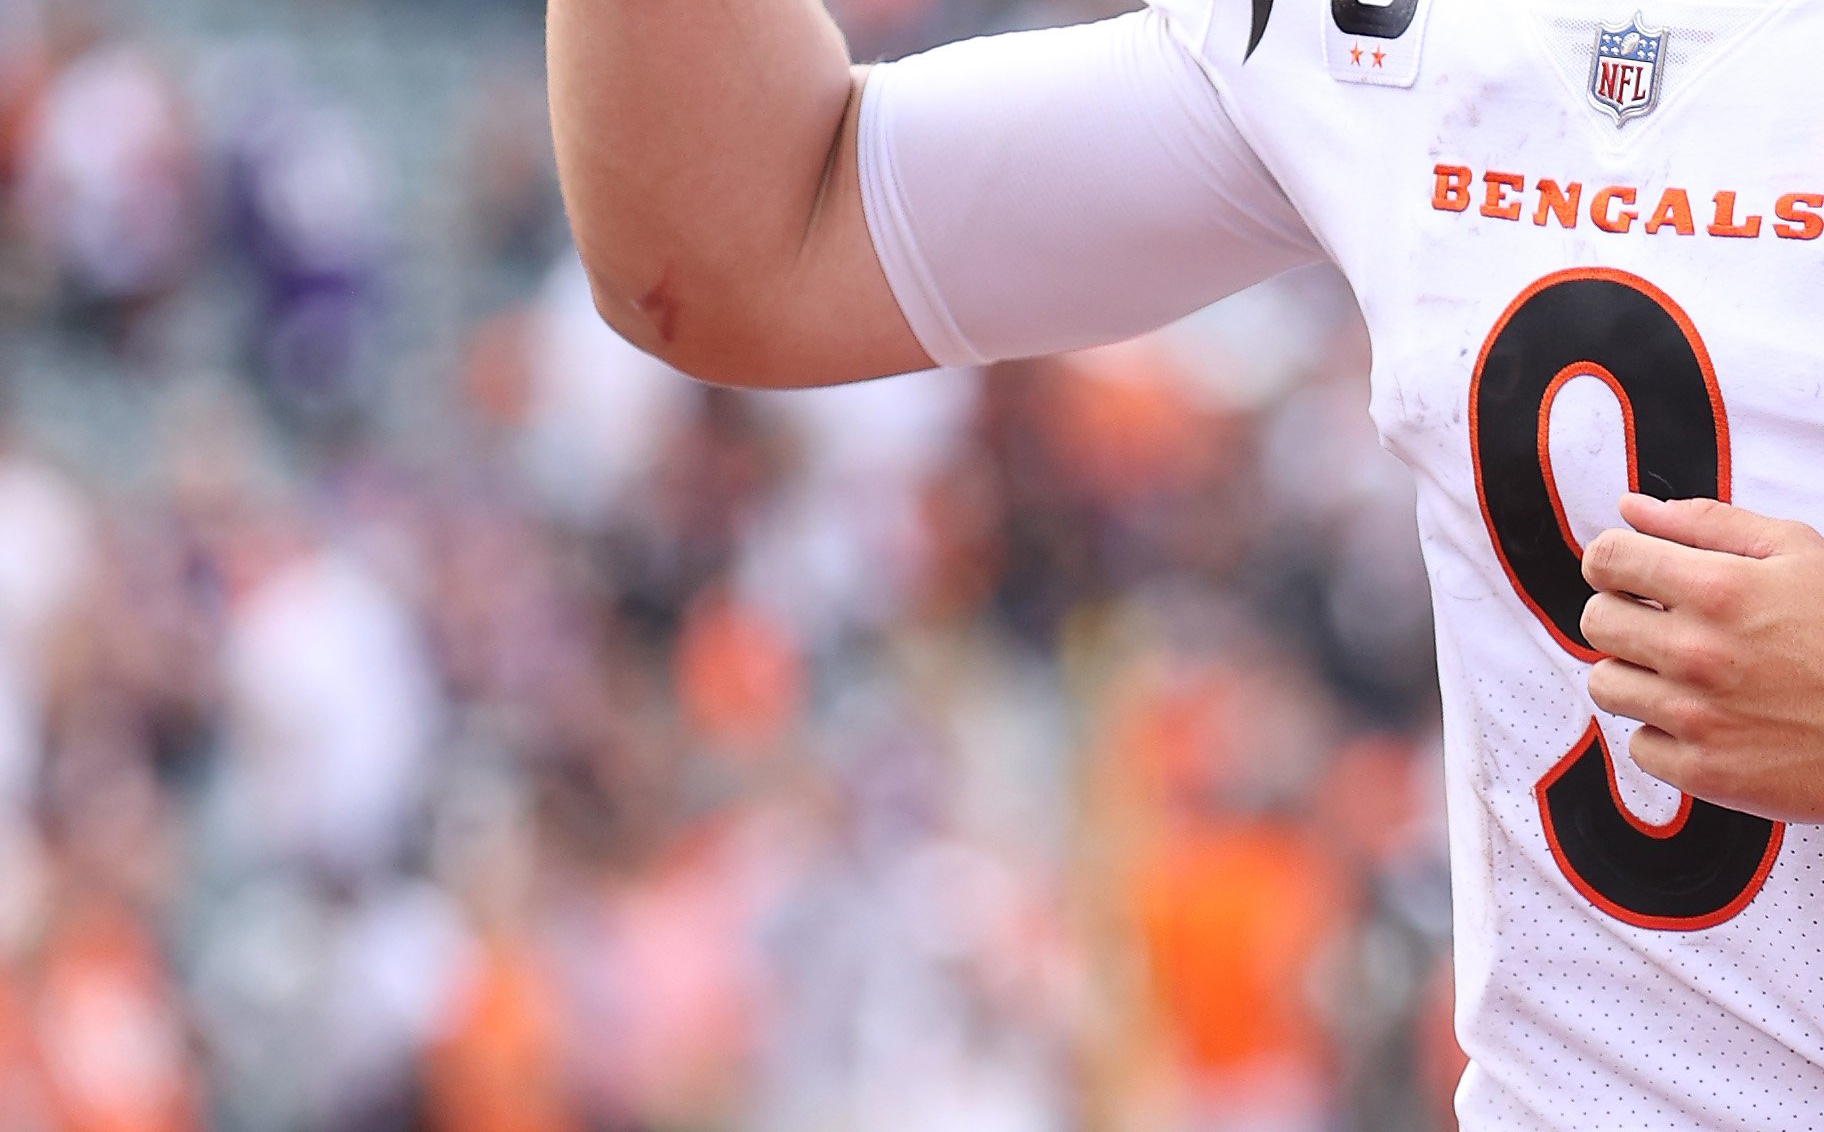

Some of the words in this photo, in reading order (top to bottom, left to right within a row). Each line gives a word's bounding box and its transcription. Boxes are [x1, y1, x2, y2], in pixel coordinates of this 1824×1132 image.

[1598, 61, 1646, 104] NFL
[1432, 163, 1824, 240] BENGALS
[1468, 266, 1785, 931] 9
